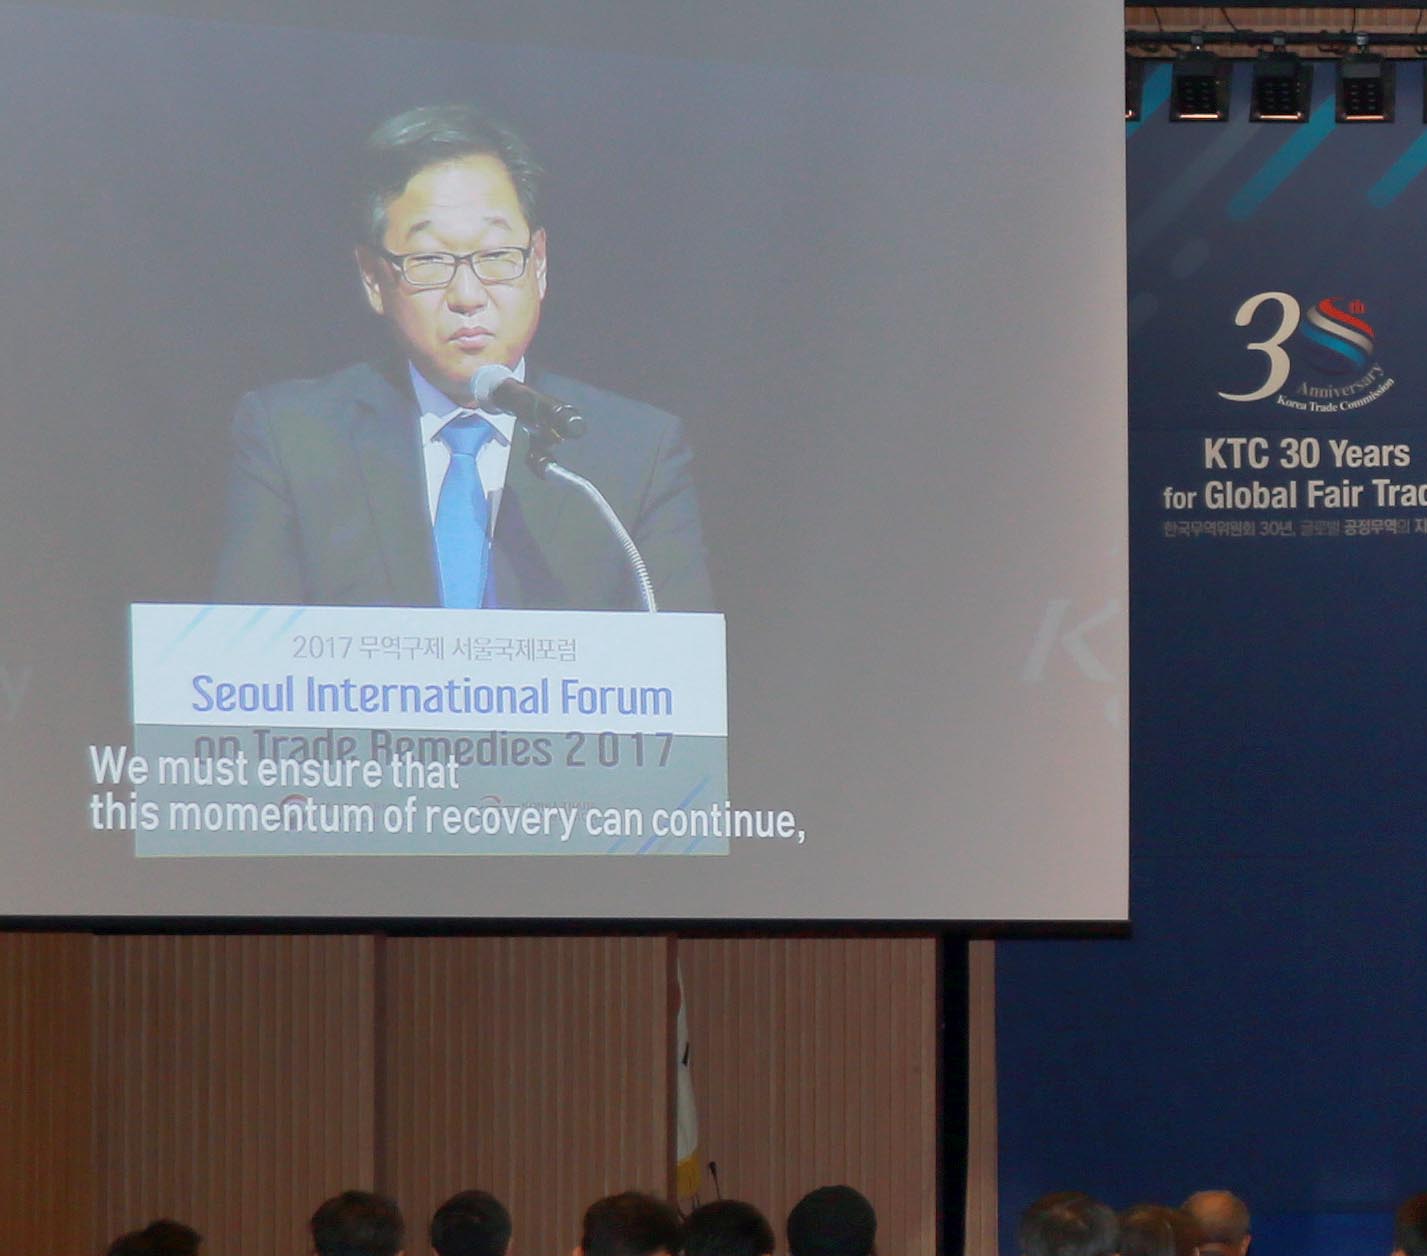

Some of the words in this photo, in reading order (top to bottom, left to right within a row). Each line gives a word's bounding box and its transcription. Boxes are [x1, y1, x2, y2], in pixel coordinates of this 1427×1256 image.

[1299, 362, 1385, 399] Anniversary
[1276, 395, 1307, 410] Korea
[1309, 401, 1338, 413] Trade
[1204, 437, 1270, 469] KTC
[1279, 437, 1320, 469] 30
[1329, 438, 1410, 468] Years
[1163, 486, 1198, 510] for
[1205, 480, 1297, 509] Global
[1307, 479, 1364, 508] Fair
[293, 635, 354, 659] 2017
[359, 636, 445, 660] 무역구제
[452, 637, 577, 662] 서울국제포럼
[192, 674, 294, 712] Seoul
[307, 675, 549, 715] International
[561, 678, 673, 716] Forum
[253, 728, 358, 766] Trade
[371, 729, 553, 767] Remedies
[89, 745, 149, 786] We
[158, 751, 249, 787] must
[257, 754, 383, 788] ensure
[391, 751, 460, 789] that
[90, 791, 160, 831] this
[169, 796, 374, 833] momentum
[384, 795, 418, 833] of
[426, 804, 579, 841] recovery
[586, 806, 643, 836] can
[652, 801, 806, 844] continue,
